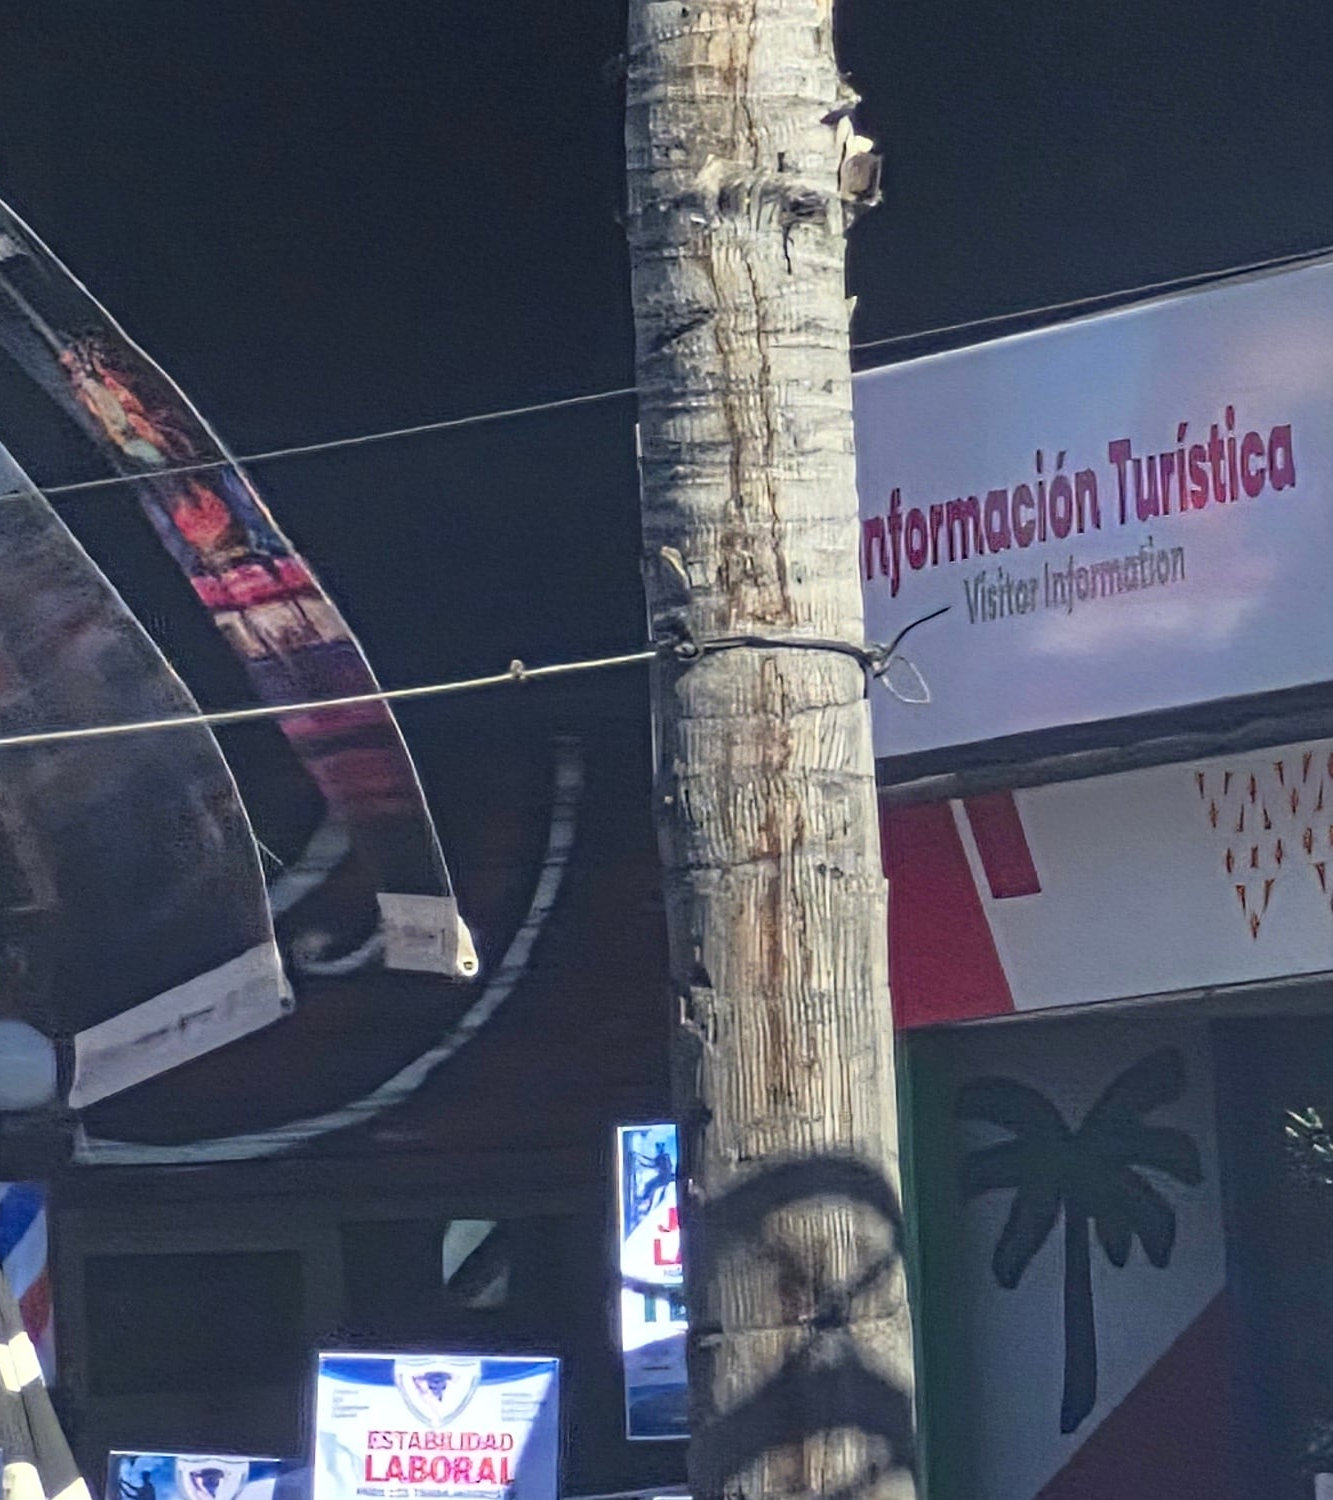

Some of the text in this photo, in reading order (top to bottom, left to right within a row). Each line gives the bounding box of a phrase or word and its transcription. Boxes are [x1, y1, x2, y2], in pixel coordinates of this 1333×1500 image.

[860, 405, 1297, 599] nformación Turística
[964, 535, 1187, 625] Visitor Information
[365, 1454, 515, 1485] LABORAL
[367, 1430, 514, 1451] ESTABILIDAD
